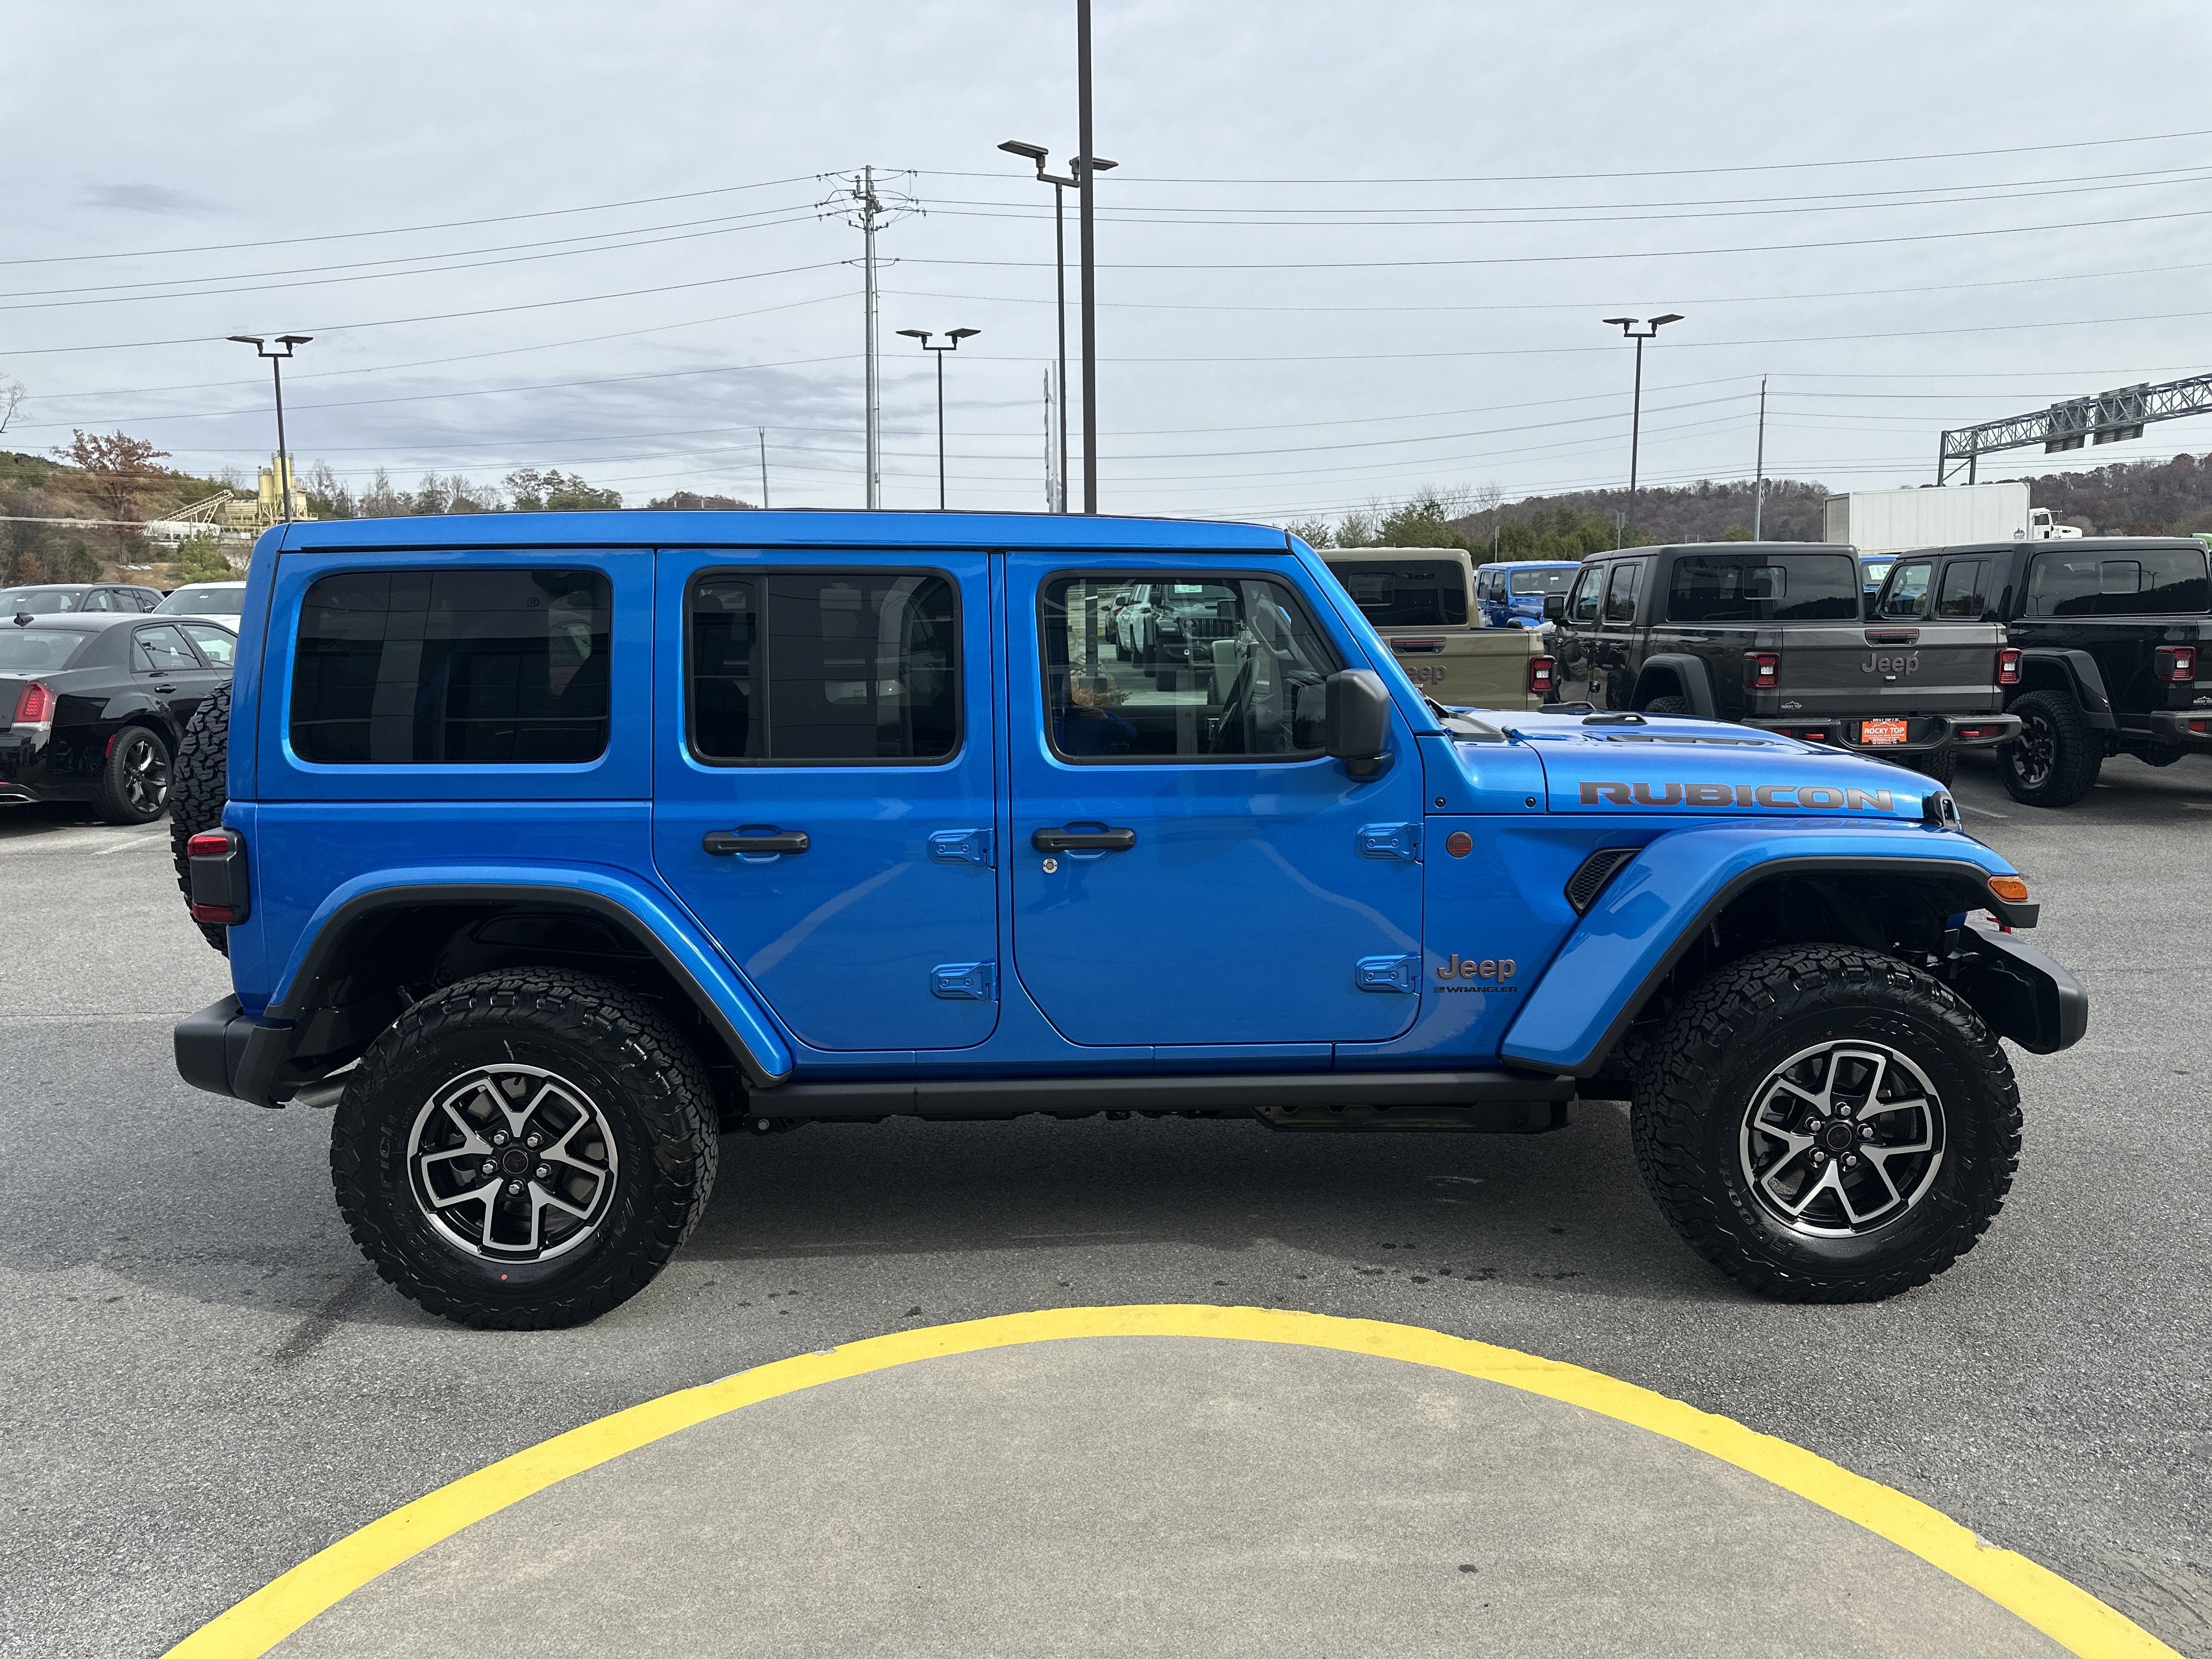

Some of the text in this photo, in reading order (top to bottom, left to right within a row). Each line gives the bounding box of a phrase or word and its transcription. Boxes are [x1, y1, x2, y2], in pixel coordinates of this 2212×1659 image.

[1404, 665, 1447, 685] eep
[1861, 653, 1919, 675] Jeep
[1579, 781, 1894, 811] RUBICON
[1437, 953, 1516, 983] Jeep
